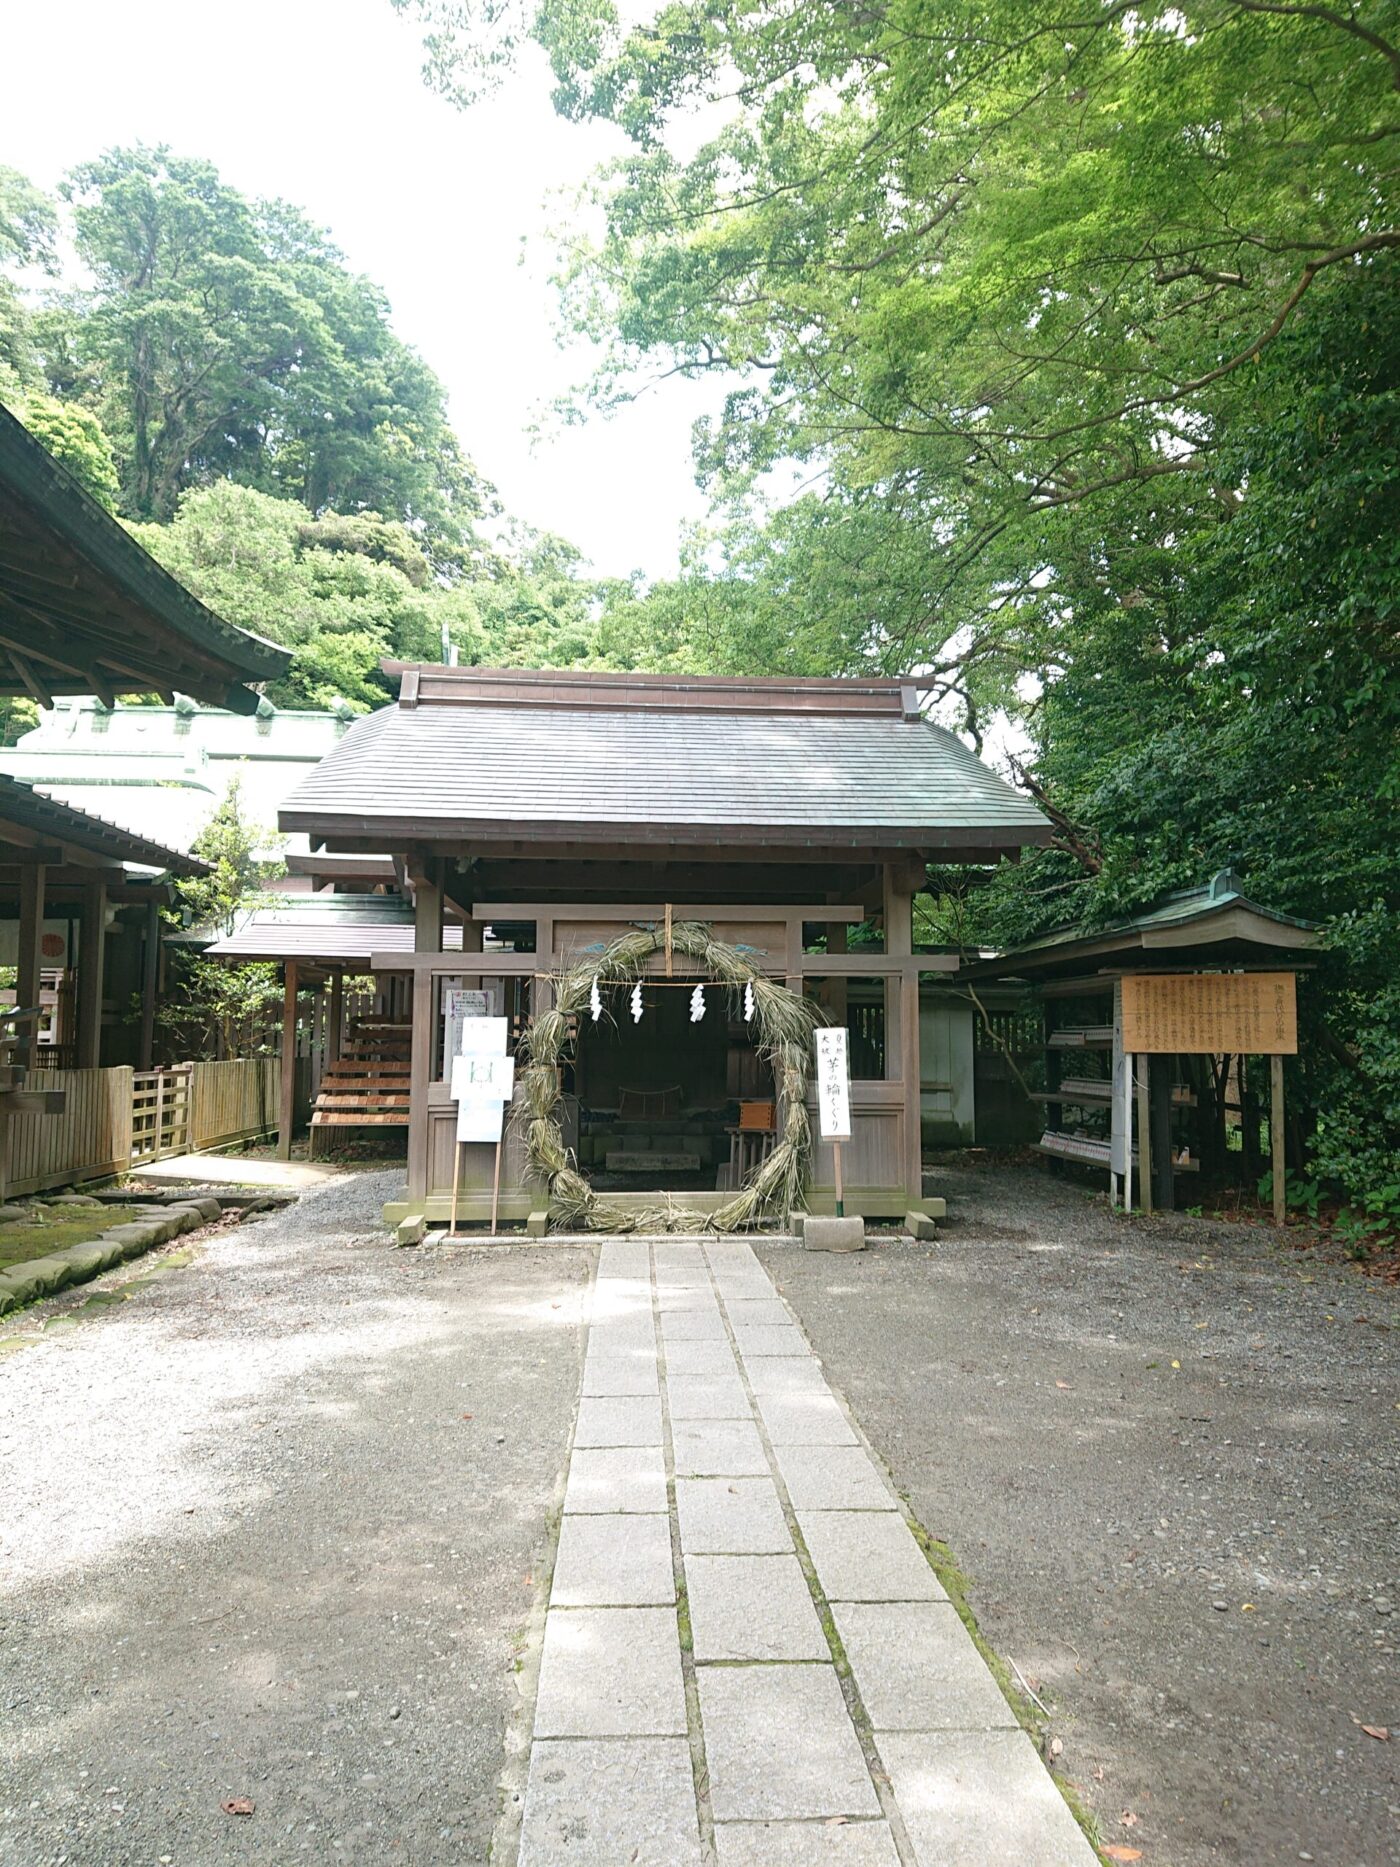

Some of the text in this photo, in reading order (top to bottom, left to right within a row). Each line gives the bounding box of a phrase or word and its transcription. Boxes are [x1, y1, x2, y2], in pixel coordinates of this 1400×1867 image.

[825, 1057, 840, 1131] 茅の輪くぐり
